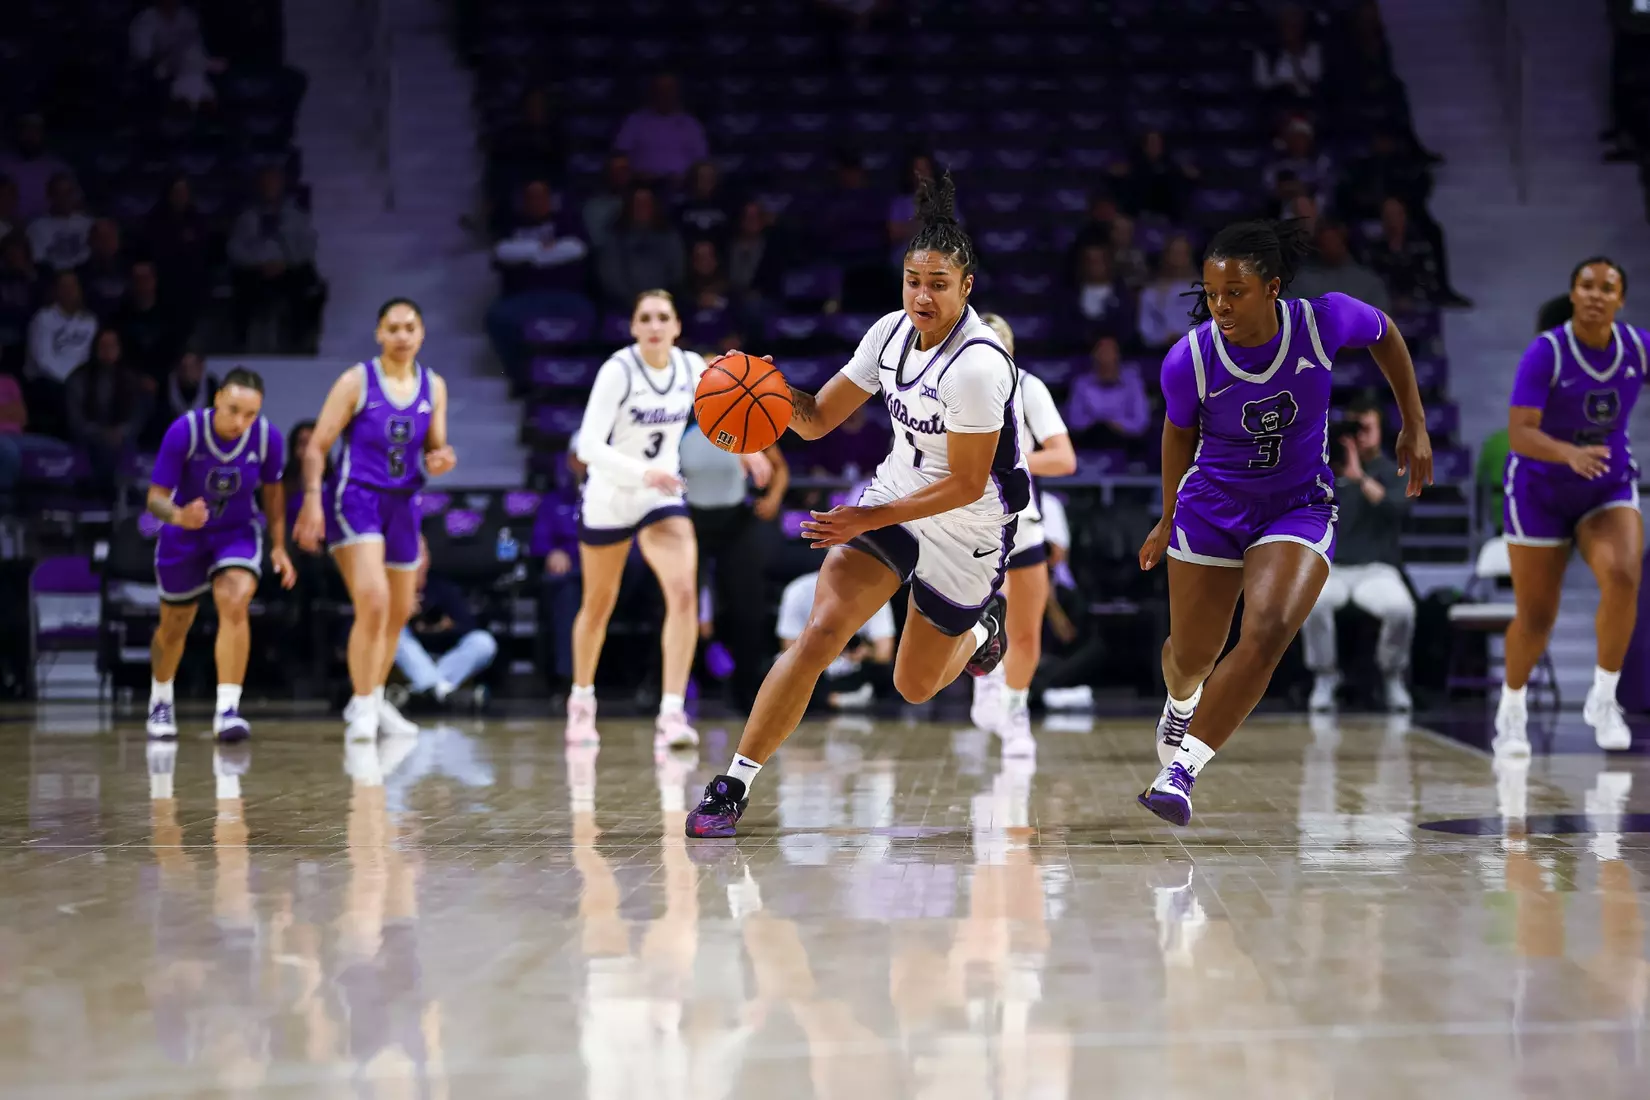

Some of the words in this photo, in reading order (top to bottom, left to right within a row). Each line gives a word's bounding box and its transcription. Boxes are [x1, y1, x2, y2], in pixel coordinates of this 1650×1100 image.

[643, 430, 664, 460] 3
[904, 430, 923, 469] 1
[1248, 434, 1283, 468] 3
